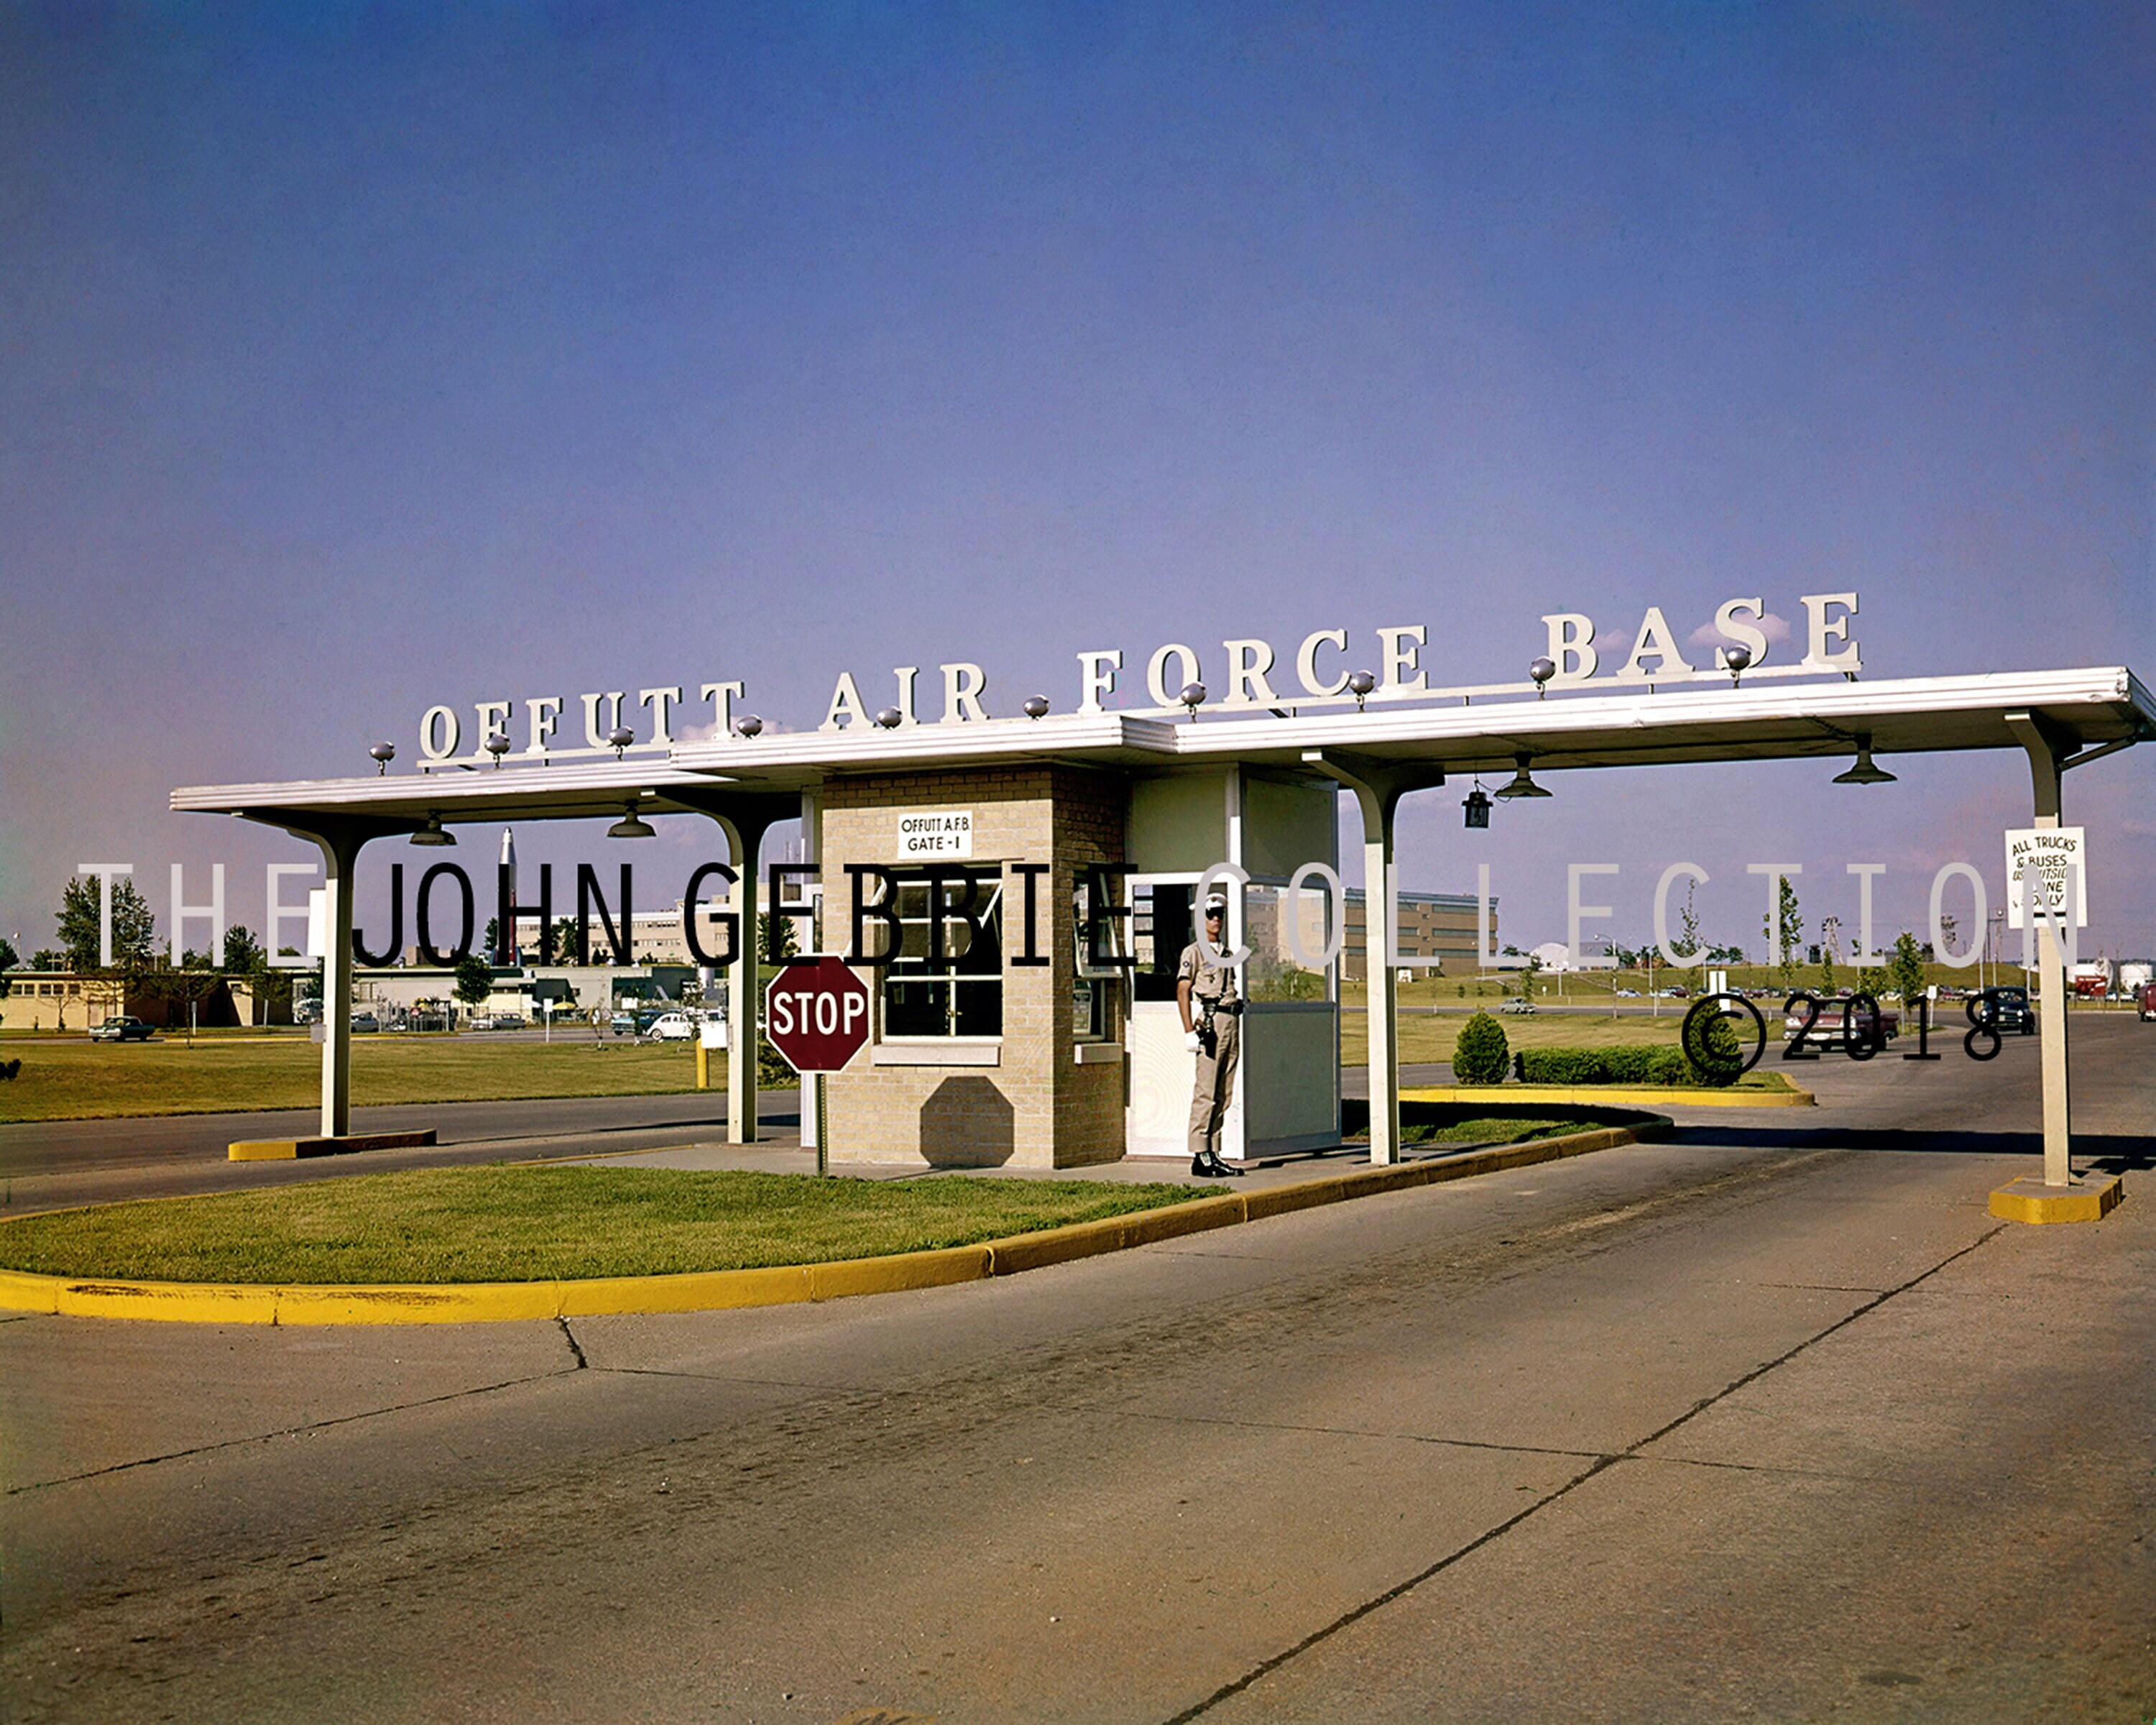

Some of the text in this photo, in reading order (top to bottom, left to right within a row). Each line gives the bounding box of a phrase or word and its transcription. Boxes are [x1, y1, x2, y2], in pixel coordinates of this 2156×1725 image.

[420, 592, 1861, 759] OFFUTT AIR FORCE BASE
[901, 818, 941, 832] OFFUTT
[908, 837, 944, 851] GATE
[2013, 836, 2077, 856] ALL TRUCKS
[2028, 855, 2067, 868] BUSES
[773, 991, 865, 1036] STOP
